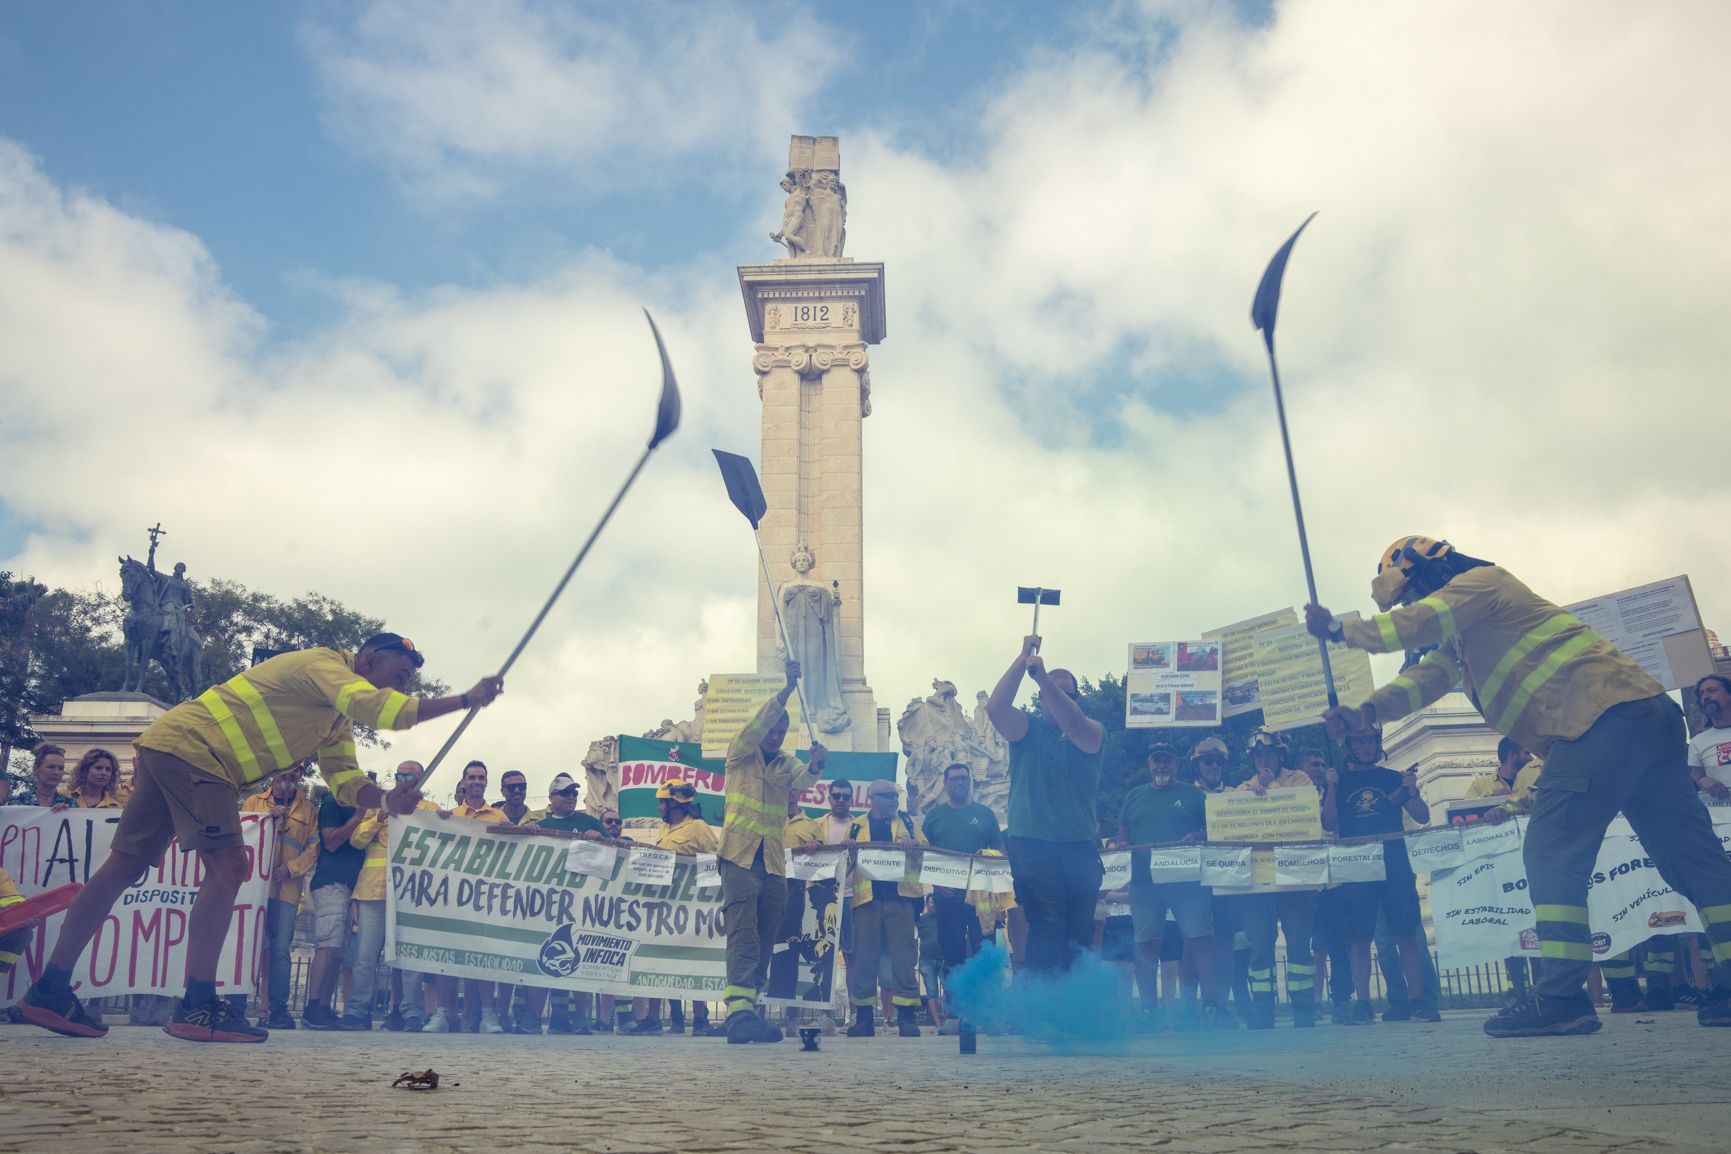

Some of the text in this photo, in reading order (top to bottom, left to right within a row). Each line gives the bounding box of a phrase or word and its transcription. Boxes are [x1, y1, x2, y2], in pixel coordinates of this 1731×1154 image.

[793, 305, 830, 322] 1812
[1466, 829, 1516, 846] LABORALES
[1411, 841, 1461, 857] DERECHOS
[873, 859, 902, 867] MIENTE
[1153, 858, 1200, 868] ANDALUCÍA
[1332, 855, 1383, 864] FORESTALES
[924, 865, 968, 876] DISPOSITIVO
[1456, 863, 1496, 887] SIN EPIS
[1502, 878, 1528, 893] BO
[1608, 857, 1657, 881] FORE
[392, 865, 727, 940] PARA DEFENDER NUESTRO MO
[1445, 904, 1531, 919] SIN ESTABILIDAD
[1611, 907, 1629, 923] SIN
[1461, 916, 1510, 926] LABORAL
[576, 933, 633, 952] MOVIMIENTO
[420, 947, 456, 965] JUSTAS
[464, 951, 525, 972] ESTABILIDAD
[581, 947, 627, 968] INFOCA
